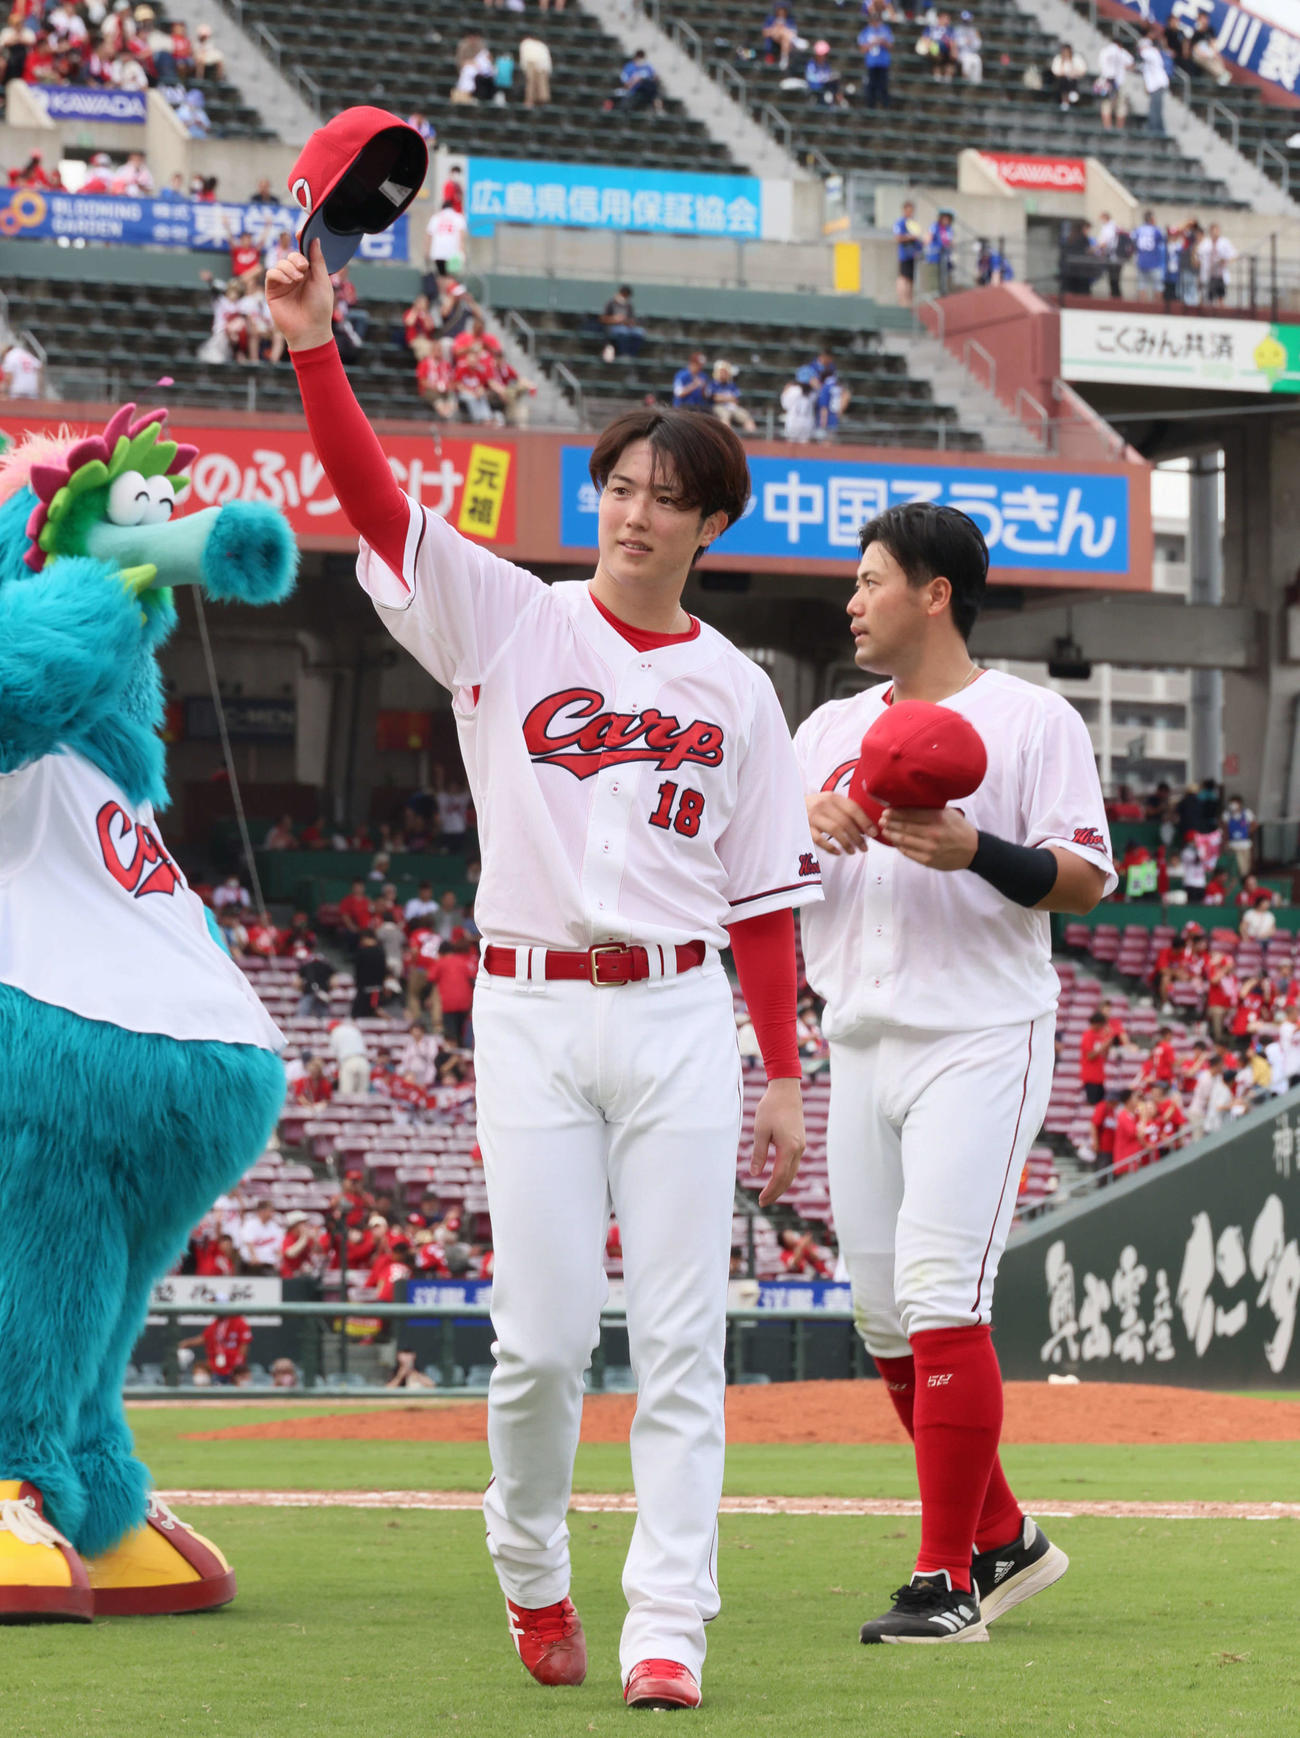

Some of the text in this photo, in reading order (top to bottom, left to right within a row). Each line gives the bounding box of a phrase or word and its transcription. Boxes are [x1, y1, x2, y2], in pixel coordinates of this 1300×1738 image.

[49, 91, 147, 117] KAWADA
[998, 161, 1085, 186] KAWADA
[51, 198, 142, 221] BLOOMING
[470, 178, 757, 232] 広島県信用保証協会
[1096, 324, 1234, 360] こくみん共済
[467, 458, 499, 525] 元祖
[522, 687, 724, 775] Carp
[648, 780, 705, 838] 18
